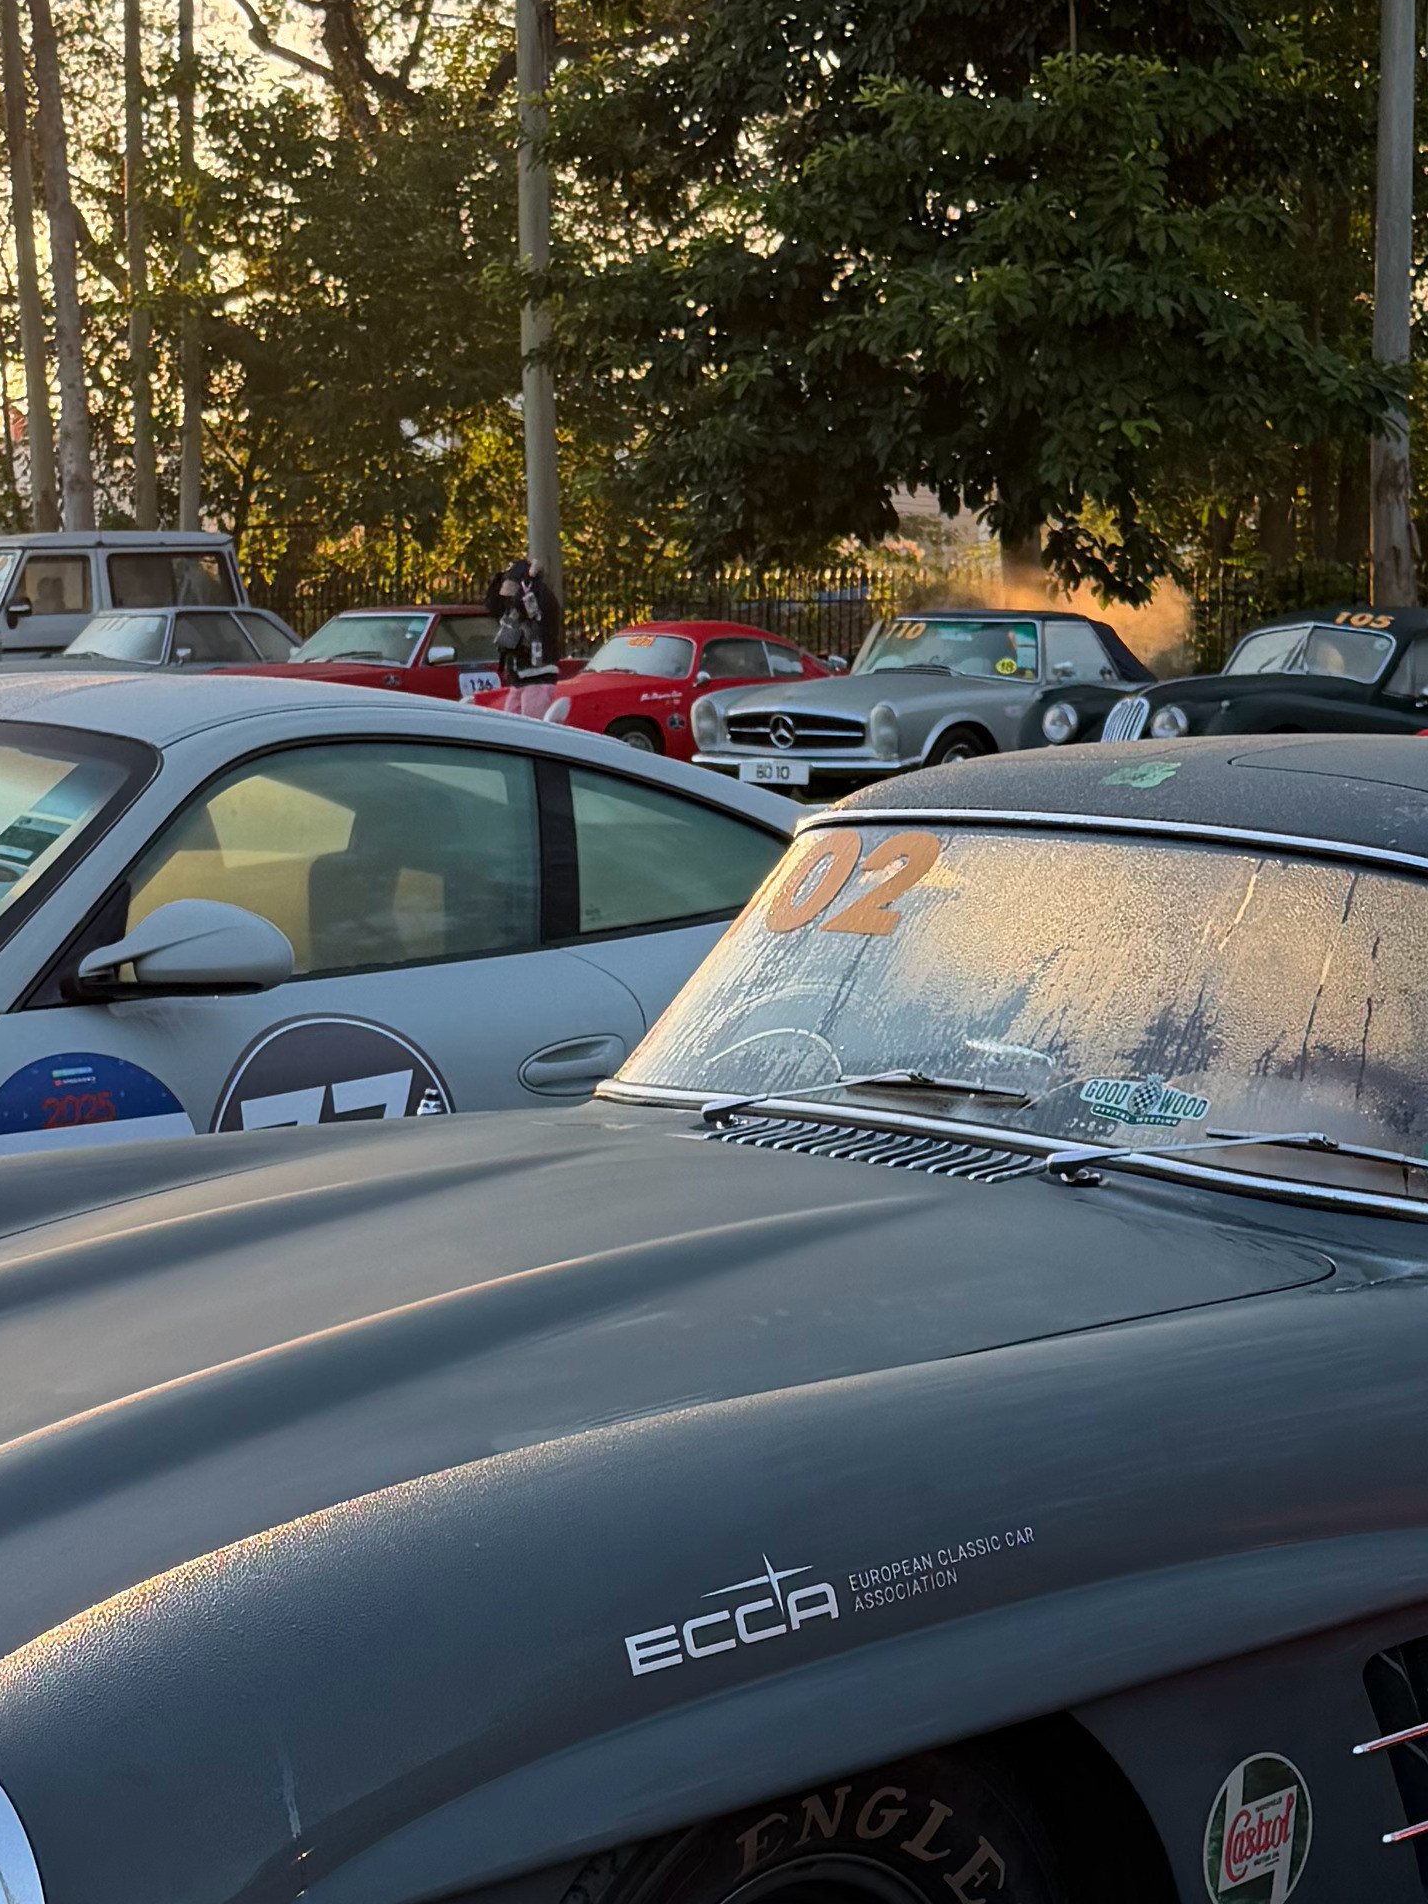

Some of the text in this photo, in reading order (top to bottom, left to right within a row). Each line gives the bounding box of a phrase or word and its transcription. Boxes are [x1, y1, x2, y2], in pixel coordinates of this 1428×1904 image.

[885, 622, 927, 640] 110
[1334, 611, 1395, 629] 105
[765, 828, 942, 936] 02
[1084, 1080, 1208, 1118] GOOD WOOD
[848, 1526, 1035, 1593] EUROPEAN CLASSIC CAR
[854, 1568, 958, 1613] ASSOCIATION
[624, 1581, 840, 1677] ECCA
[1225, 1793, 1295, 1883] Castrol
